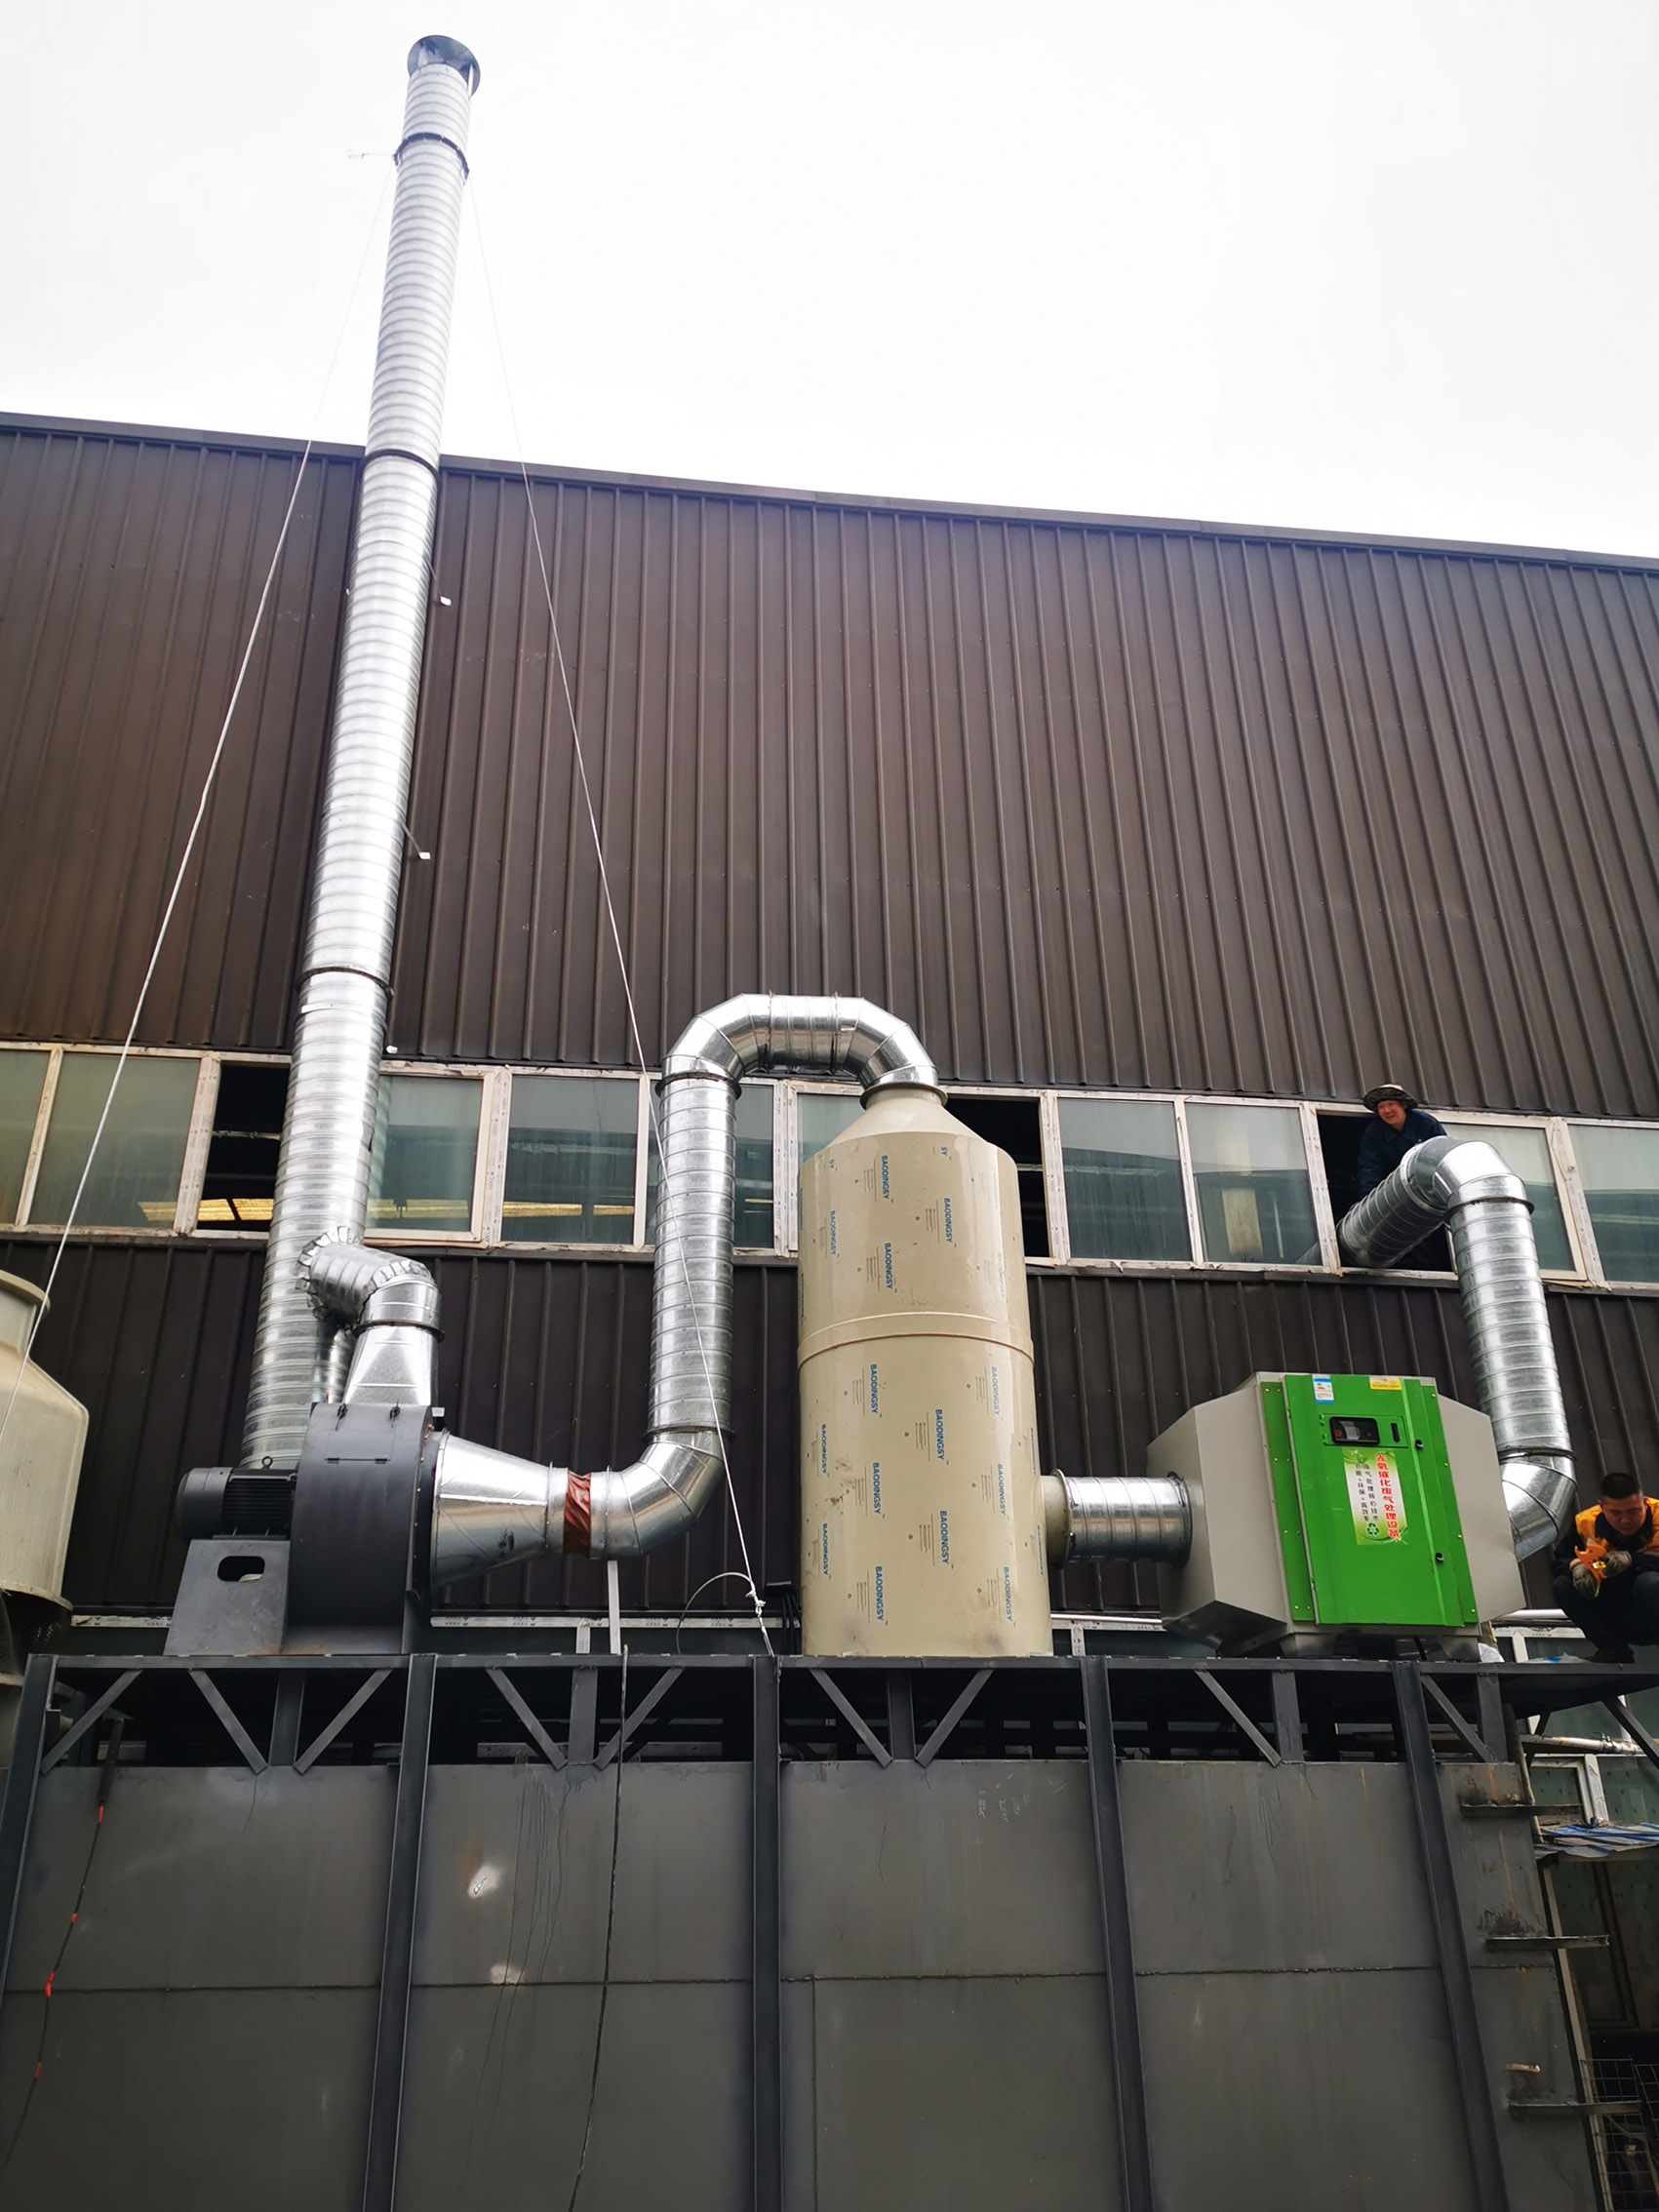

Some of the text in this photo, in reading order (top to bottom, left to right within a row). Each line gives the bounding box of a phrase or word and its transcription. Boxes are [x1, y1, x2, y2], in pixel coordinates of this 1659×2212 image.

[882, 1155, 890, 1199] BAODINGSY
[944, 1198, 953, 1244] BAODINGSY
[885, 1243, 893, 1289] BAODINGSY
[870, 1363, 880, 1414] BAODINGSY
[991, 1365, 1000, 1415] BAODINGSY
[935, 1408, 946, 1461] BAODINGSY
[872, 1462, 882, 1515] BAODINGSY
[997, 1463, 1007, 1516] BAODINGSY
[940, 1511, 950, 1564] BAODINGSY
[875, 1566, 886, 1621] BAODINGSY
[1004, 1566, 1013, 1622] BAODINGSY
